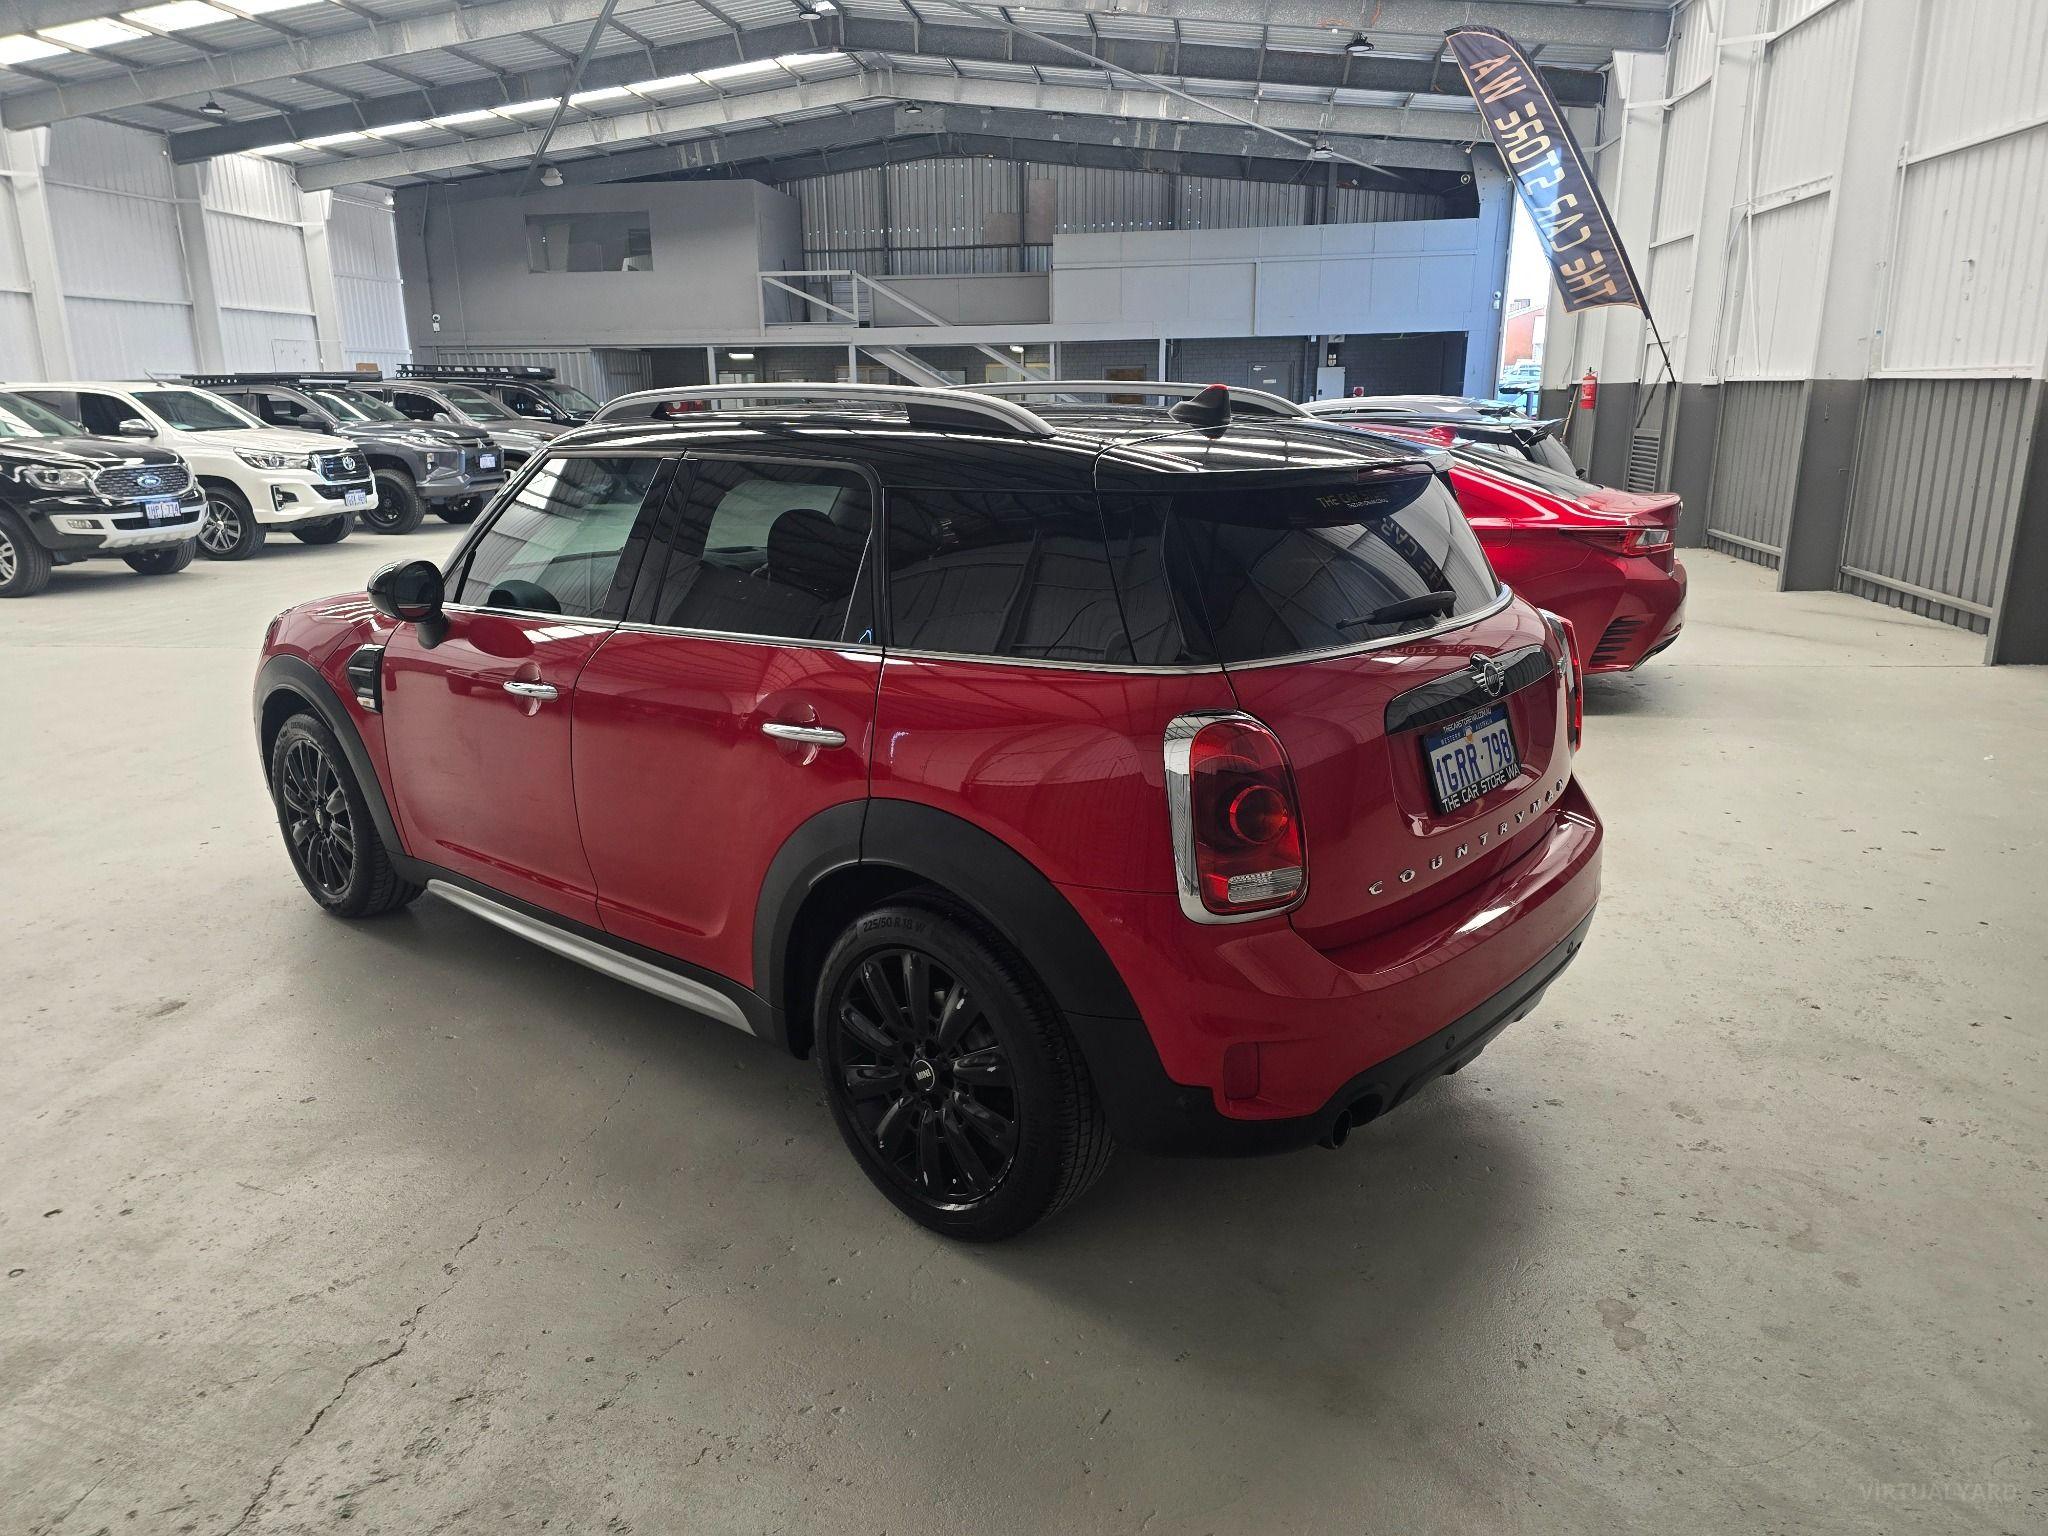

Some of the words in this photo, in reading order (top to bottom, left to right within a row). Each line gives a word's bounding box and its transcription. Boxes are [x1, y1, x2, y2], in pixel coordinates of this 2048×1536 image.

[1440, 732, 1462, 746] WESTERN
[1435, 743, 1482, 797] 1GRR
[1481, 728, 1513, 773] 798
[1441, 793, 1461, 813] THE
[1461, 783, 1480, 803] CAR
[1480, 769, 1507, 793] STORE
[1507, 763, 1521, 777] WA
[1368, 777, 1566, 896] COUNTRYMAN
[863, 916, 892, 933] 225/50
[915, 1068, 932, 1081] MINI
